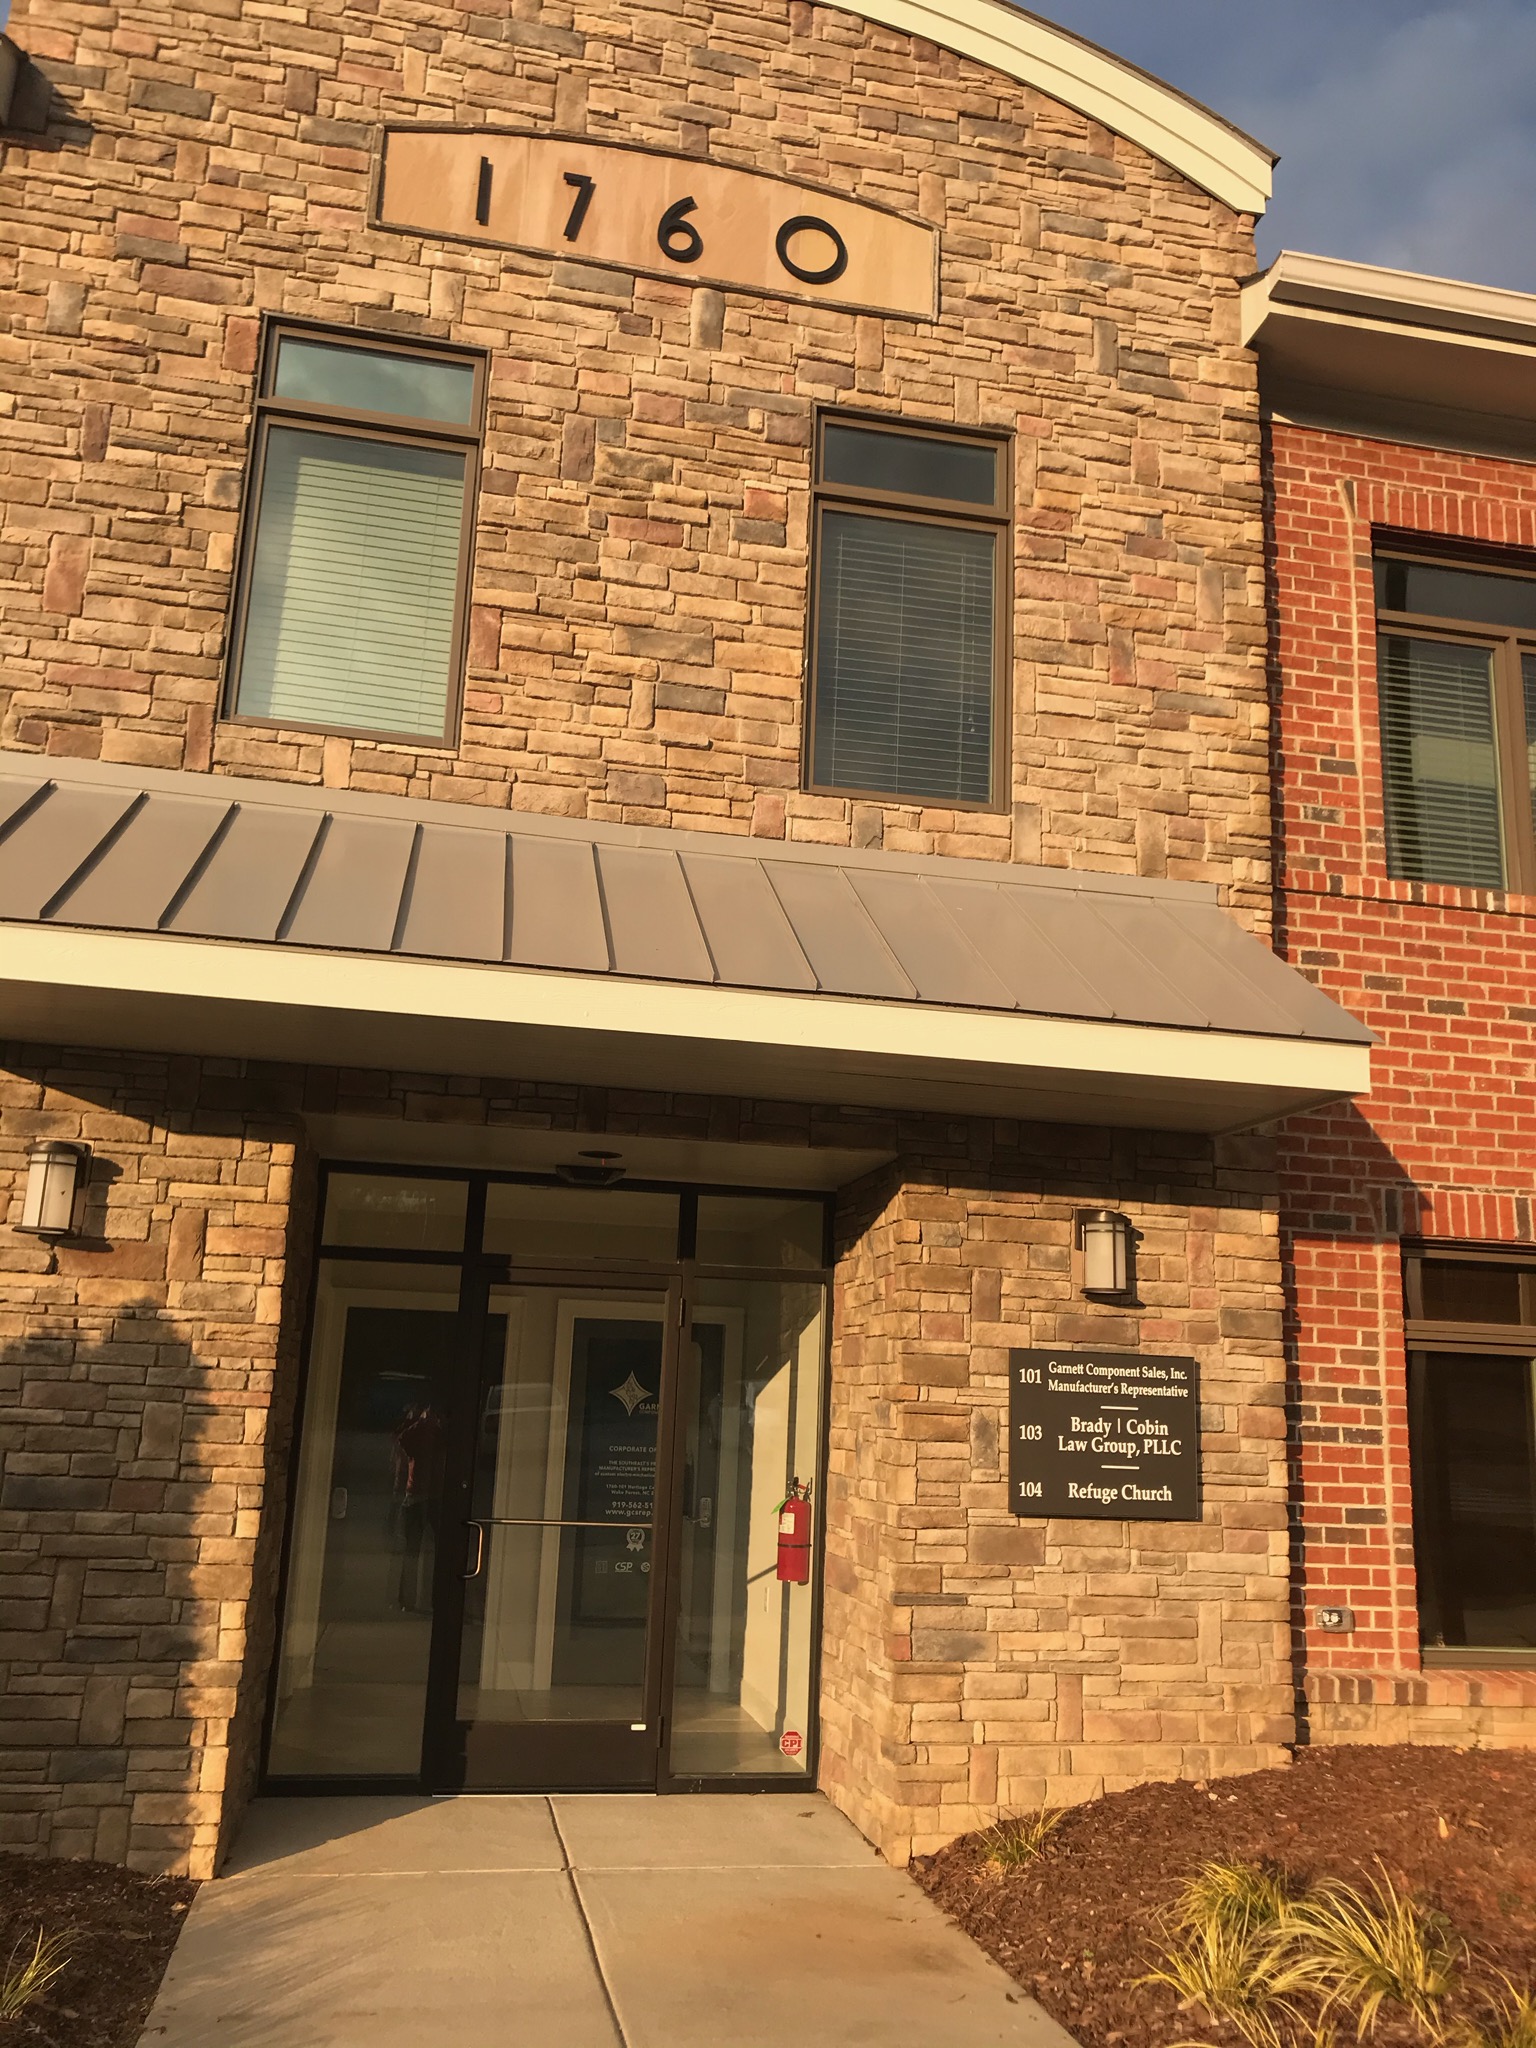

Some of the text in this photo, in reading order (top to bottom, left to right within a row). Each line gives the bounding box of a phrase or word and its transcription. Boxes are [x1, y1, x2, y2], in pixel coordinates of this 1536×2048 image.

[475, 156, 849, 285] 1760
[1019, 1368, 1042, 1384] 101
[1048, 1361, 1188, 1381] Garnett Component Sales, Inc.
[1047, 1379, 1189, 1399] Manufacturer's Representative
[1019, 1424, 1043, 1441] 103
[1070, 1416, 1112, 1438] Brady
[1126, 1418, 1169, 1436] Cobin
[608, 1445, 647, 1453] CORPORATE
[1058, 1435, 1182, 1459] Law Group, PLLC
[1018, 1481, 1043, 1498] 104
[1068, 1482, 1173, 1505] Refuge Church
[611, 1501, 653, 1509] 919-562-51
[630, 1532, 641, 1540] 27
[614, 1561, 633, 1572] CSP
[781, 1739, 802, 1748] CPI
